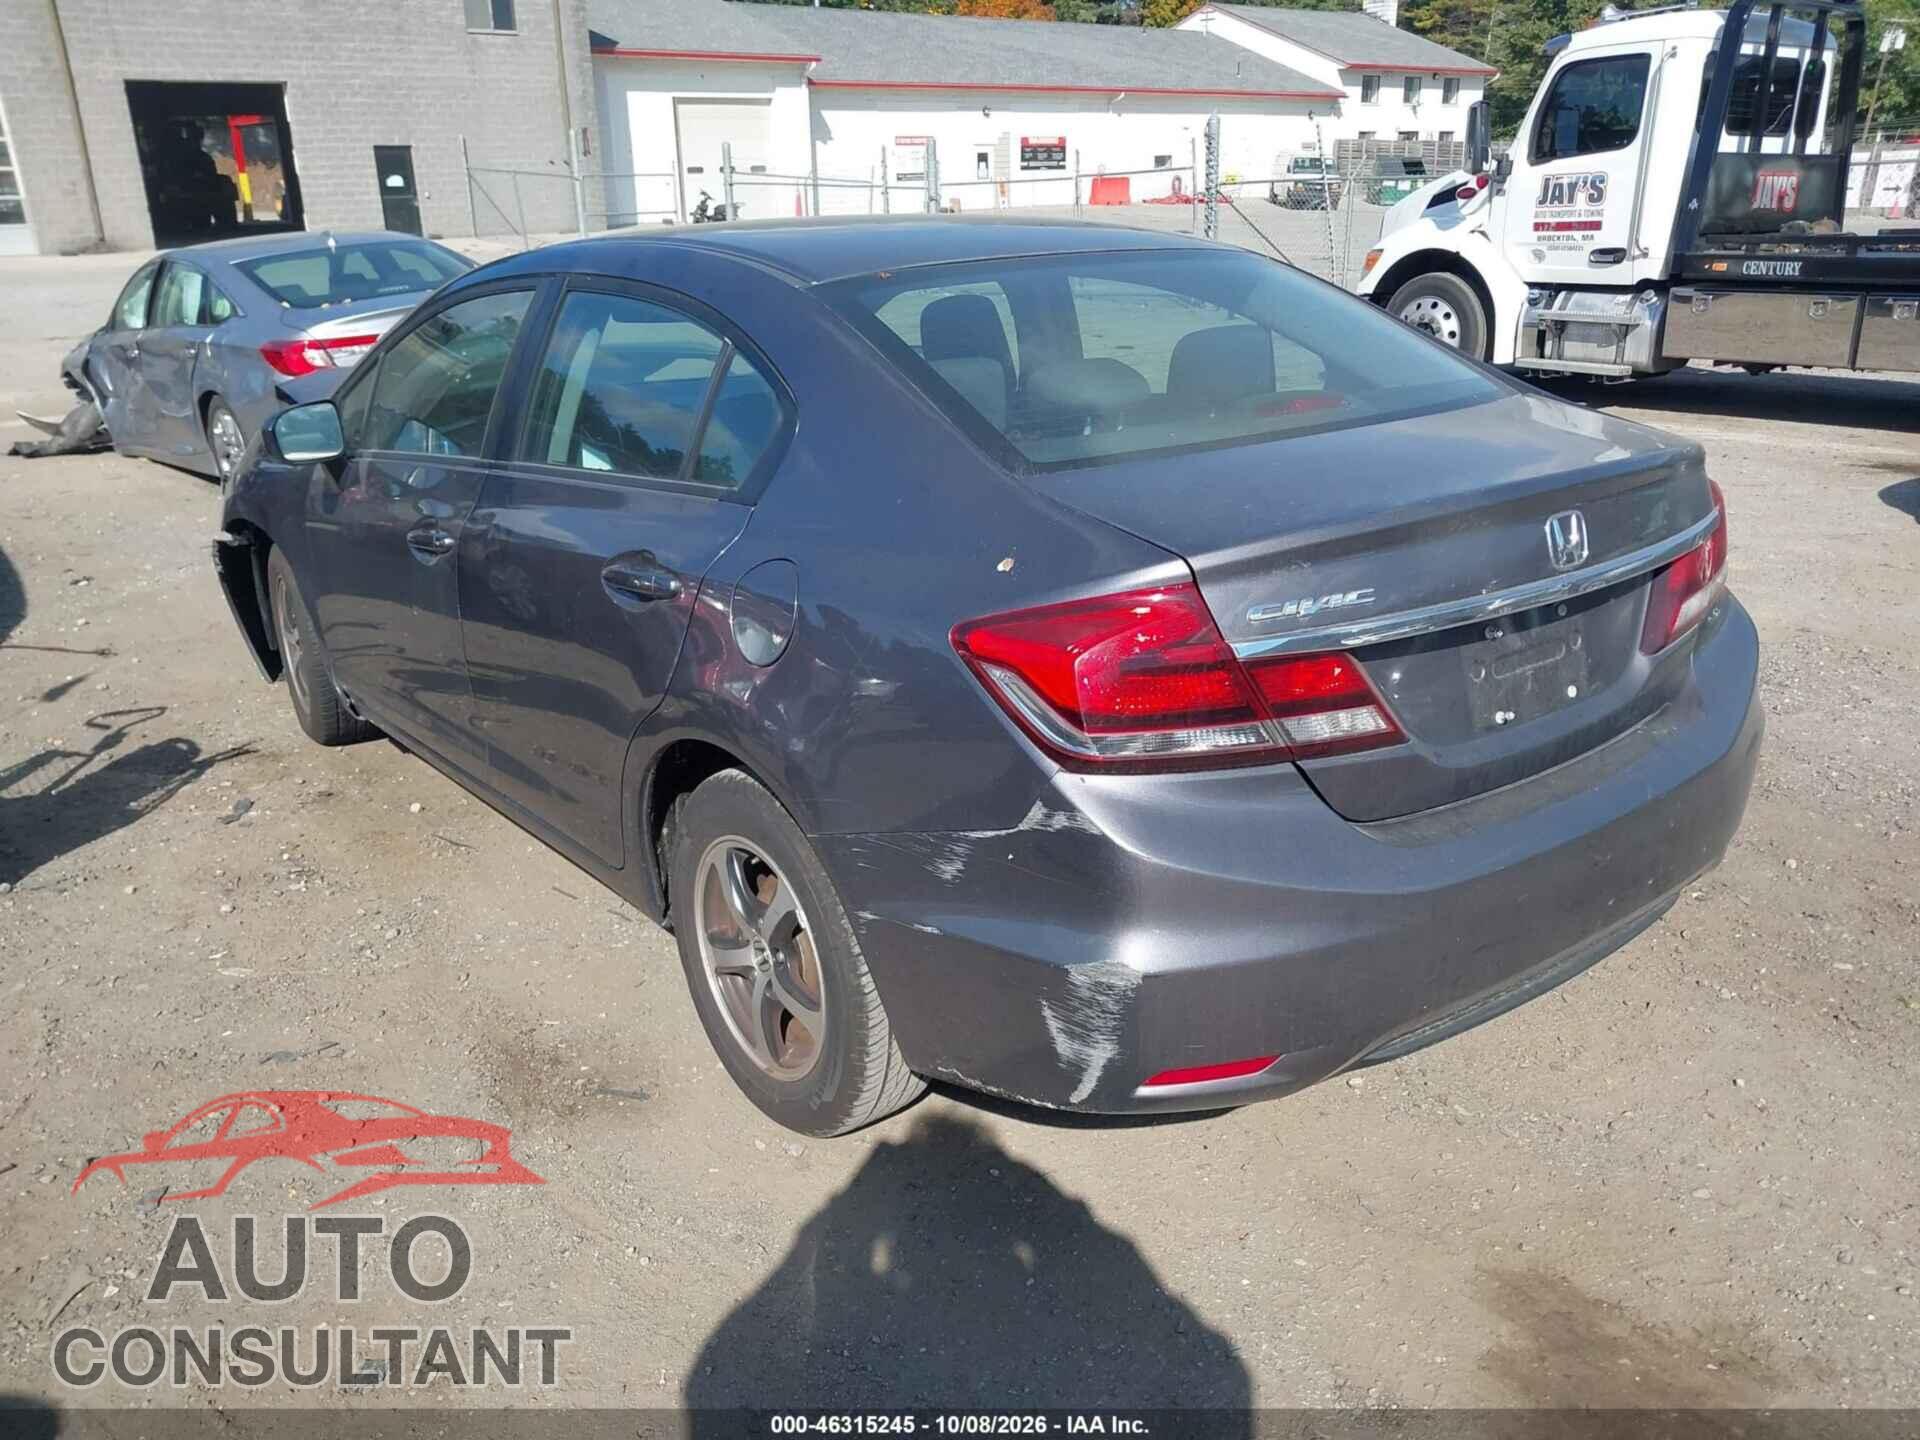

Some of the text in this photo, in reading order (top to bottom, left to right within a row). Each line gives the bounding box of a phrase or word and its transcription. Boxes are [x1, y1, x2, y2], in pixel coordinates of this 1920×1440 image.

[1537, 174, 1607, 207] JAY'S
[1751, 173, 1798, 210] JAY'S
[1743, 261, 1802, 276] CENTURY
[1247, 588, 1376, 622] CIVIC
